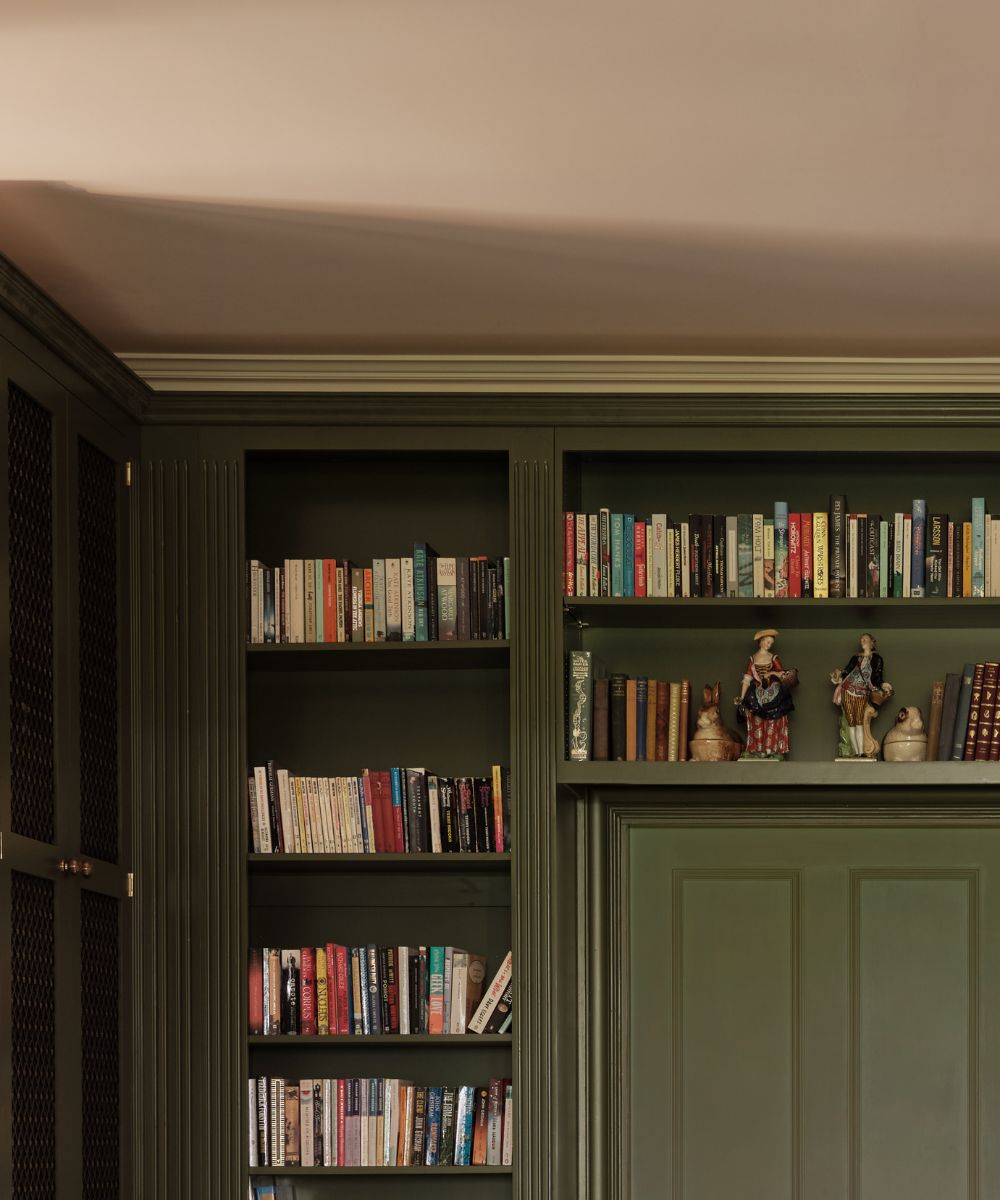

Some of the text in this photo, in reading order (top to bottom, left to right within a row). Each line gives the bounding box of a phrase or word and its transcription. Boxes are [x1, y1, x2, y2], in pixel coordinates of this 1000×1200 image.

[933, 517, 941, 546] LARSSON
[416, 549, 425, 606] KATE ATKINSON
[432, 974, 443, 993] GEEK
[302, 986, 313, 1020] CORPUS
[444, 1092, 454, 1103] THE
[415, 1116, 424, 1130] JOHN
